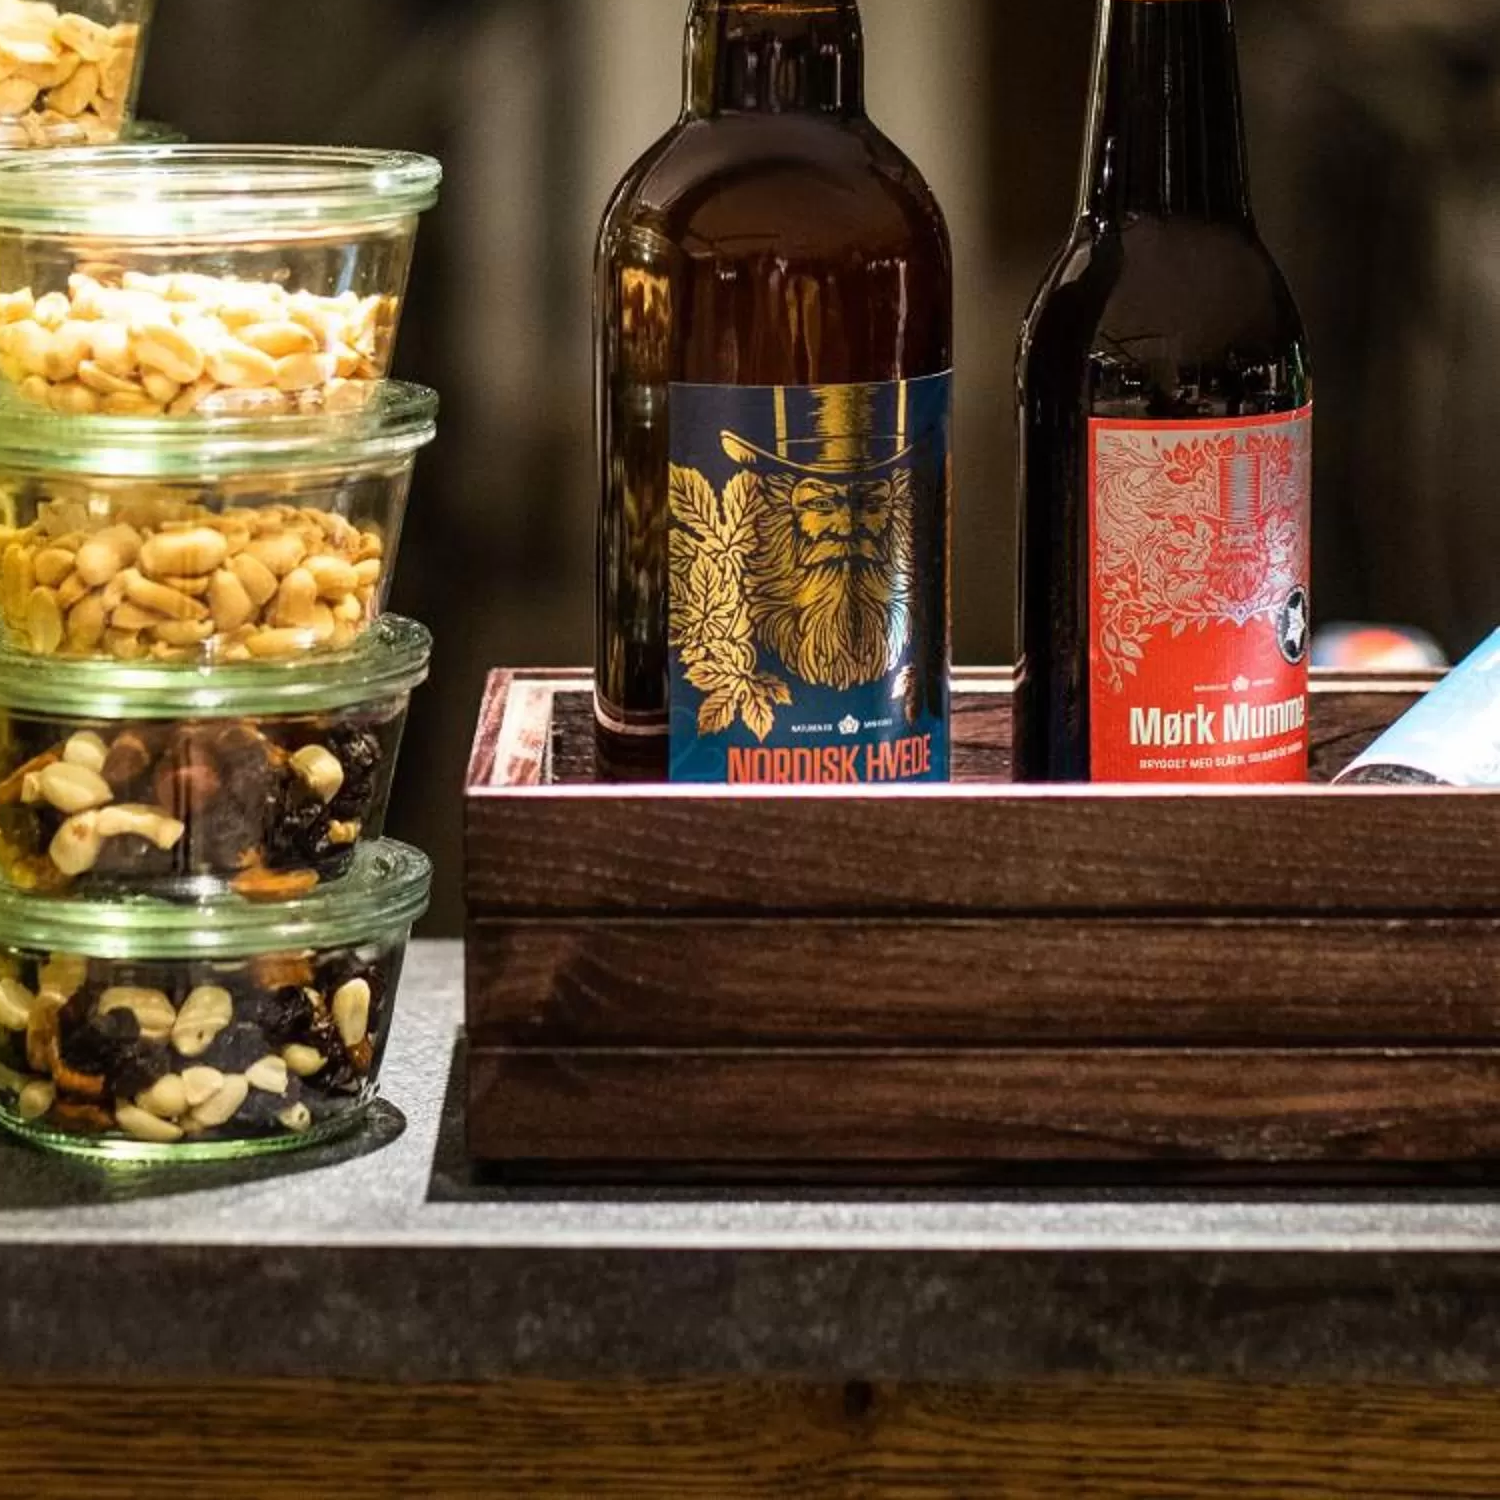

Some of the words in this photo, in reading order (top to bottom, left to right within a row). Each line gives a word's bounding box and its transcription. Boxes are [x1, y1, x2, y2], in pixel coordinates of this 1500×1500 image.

[1129, 703, 1216, 749] Mørk
[1223, 695, 1305, 744] Mumme
[727, 745, 859, 785] NORDISK
[866, 732, 931, 783] HVEDE
